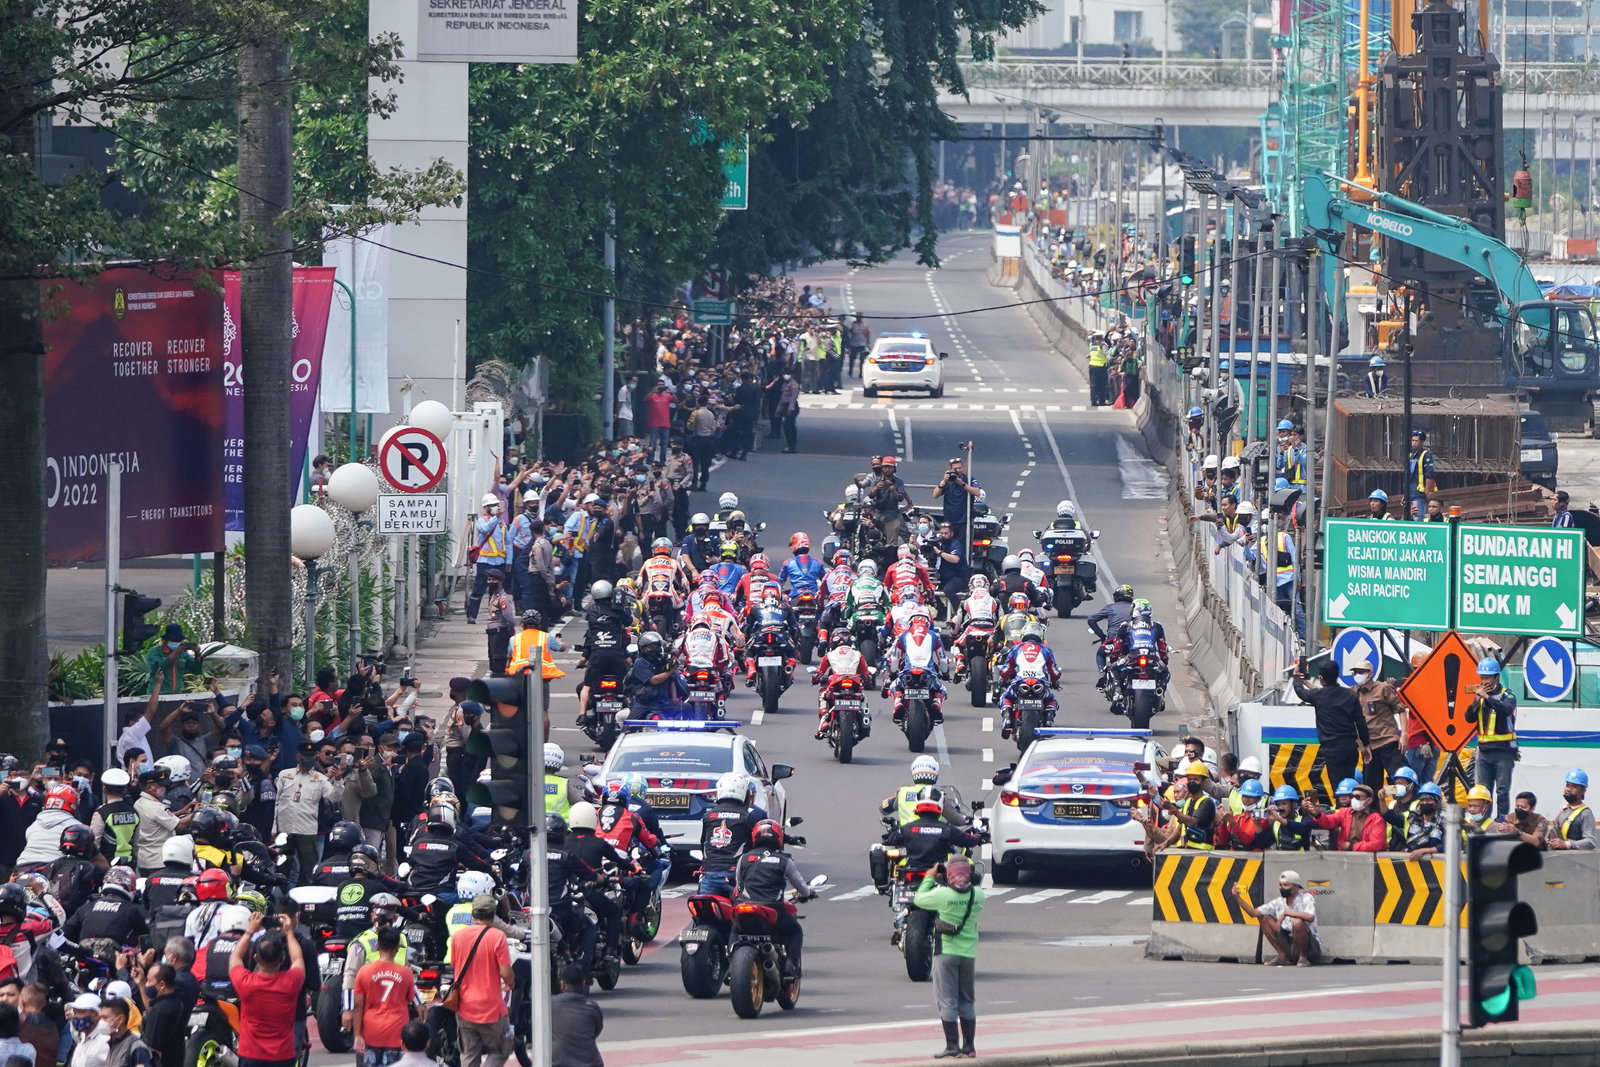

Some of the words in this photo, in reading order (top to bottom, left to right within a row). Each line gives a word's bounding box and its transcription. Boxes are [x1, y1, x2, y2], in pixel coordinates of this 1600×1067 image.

[430, 0, 506, 10] SEKRETARIAT
[508, 0, 567, 10] JENDERAL
[446, 21, 494, 30] REPUBLIK
[497, 21, 551, 30] INDONESIA
[1367, 213, 1413, 236] KOBELCO
[113, 341, 153, 358] RECOVER
[167, 338, 206, 354] RECOVER
[113, 360, 158, 376] TOGETHER
[167, 357, 211, 374] STRONGER
[63, 483, 98, 506] 2022
[389, 499, 438, 508] SAMPAI
[141, 508, 165, 521] ENERGY
[169, 504, 213, 519] TRANSITIONS
[389, 509, 437, 518] RAMBU
[384, 520, 441, 529] BERIKUT
[1348, 529, 1396, 544] BANGKOK
[1399, 531, 1427, 545] BANK
[1463, 534, 1552, 558] BUNDARAN
[1556, 538, 1572, 559] HI
[1347, 547, 1379, 560] KEJATI
[1381, 548, 1397, 561] DKI
[1400, 549, 1444, 563] JAKARTA
[1348, 565, 1382, 579] WISMA
[1384, 566, 1426, 581] MANDIRI
[1463, 563, 1557, 587] SEMANGGI
[1347, 582, 1371, 596] SARI
[1373, 584, 1410, 598] PACIFIC
[1463, 592, 1510, 615] BLOK
[1515, 595, 1531, 615] M
[46, 797, 65, 809] 93
[371, 970, 404, 983] DALGLISH
[381, 980, 395, 1002] 7
